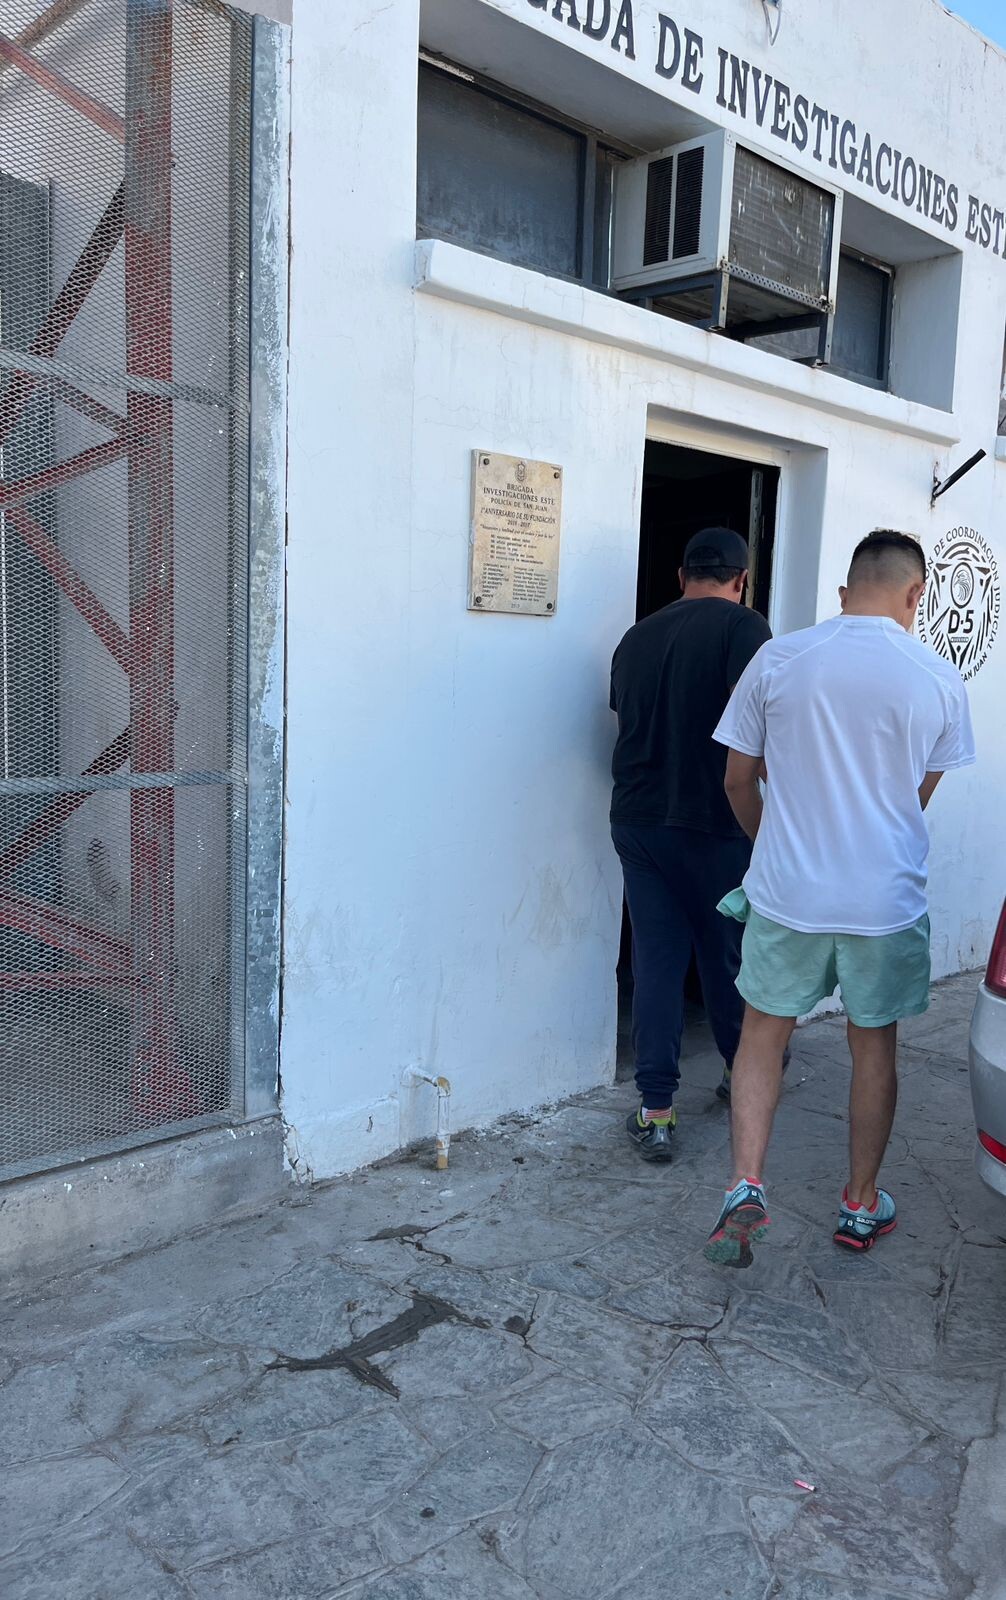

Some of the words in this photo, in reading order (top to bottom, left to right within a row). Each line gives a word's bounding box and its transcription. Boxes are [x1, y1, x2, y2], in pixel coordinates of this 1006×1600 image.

[527, 0, 635, 60] DA
[655, 13, 704, 94] DE
[716, 46, 959, 231] INVESTIGACIONES
[965, 194, 1006, 260] EST
[483, 487, 538, 503] INVESTIGACIONES
[541, 497, 555, 505] ESTE
[507, 483, 534, 494] BRIGADA
[484, 507, 515, 519] ANIVERSARIO
[523, 502, 533, 510] SAN
[933, 539, 946, 557] DE
[987, 587, 1000, 650] JUDICIAL
[973, 652, 988, 677] JUAN
